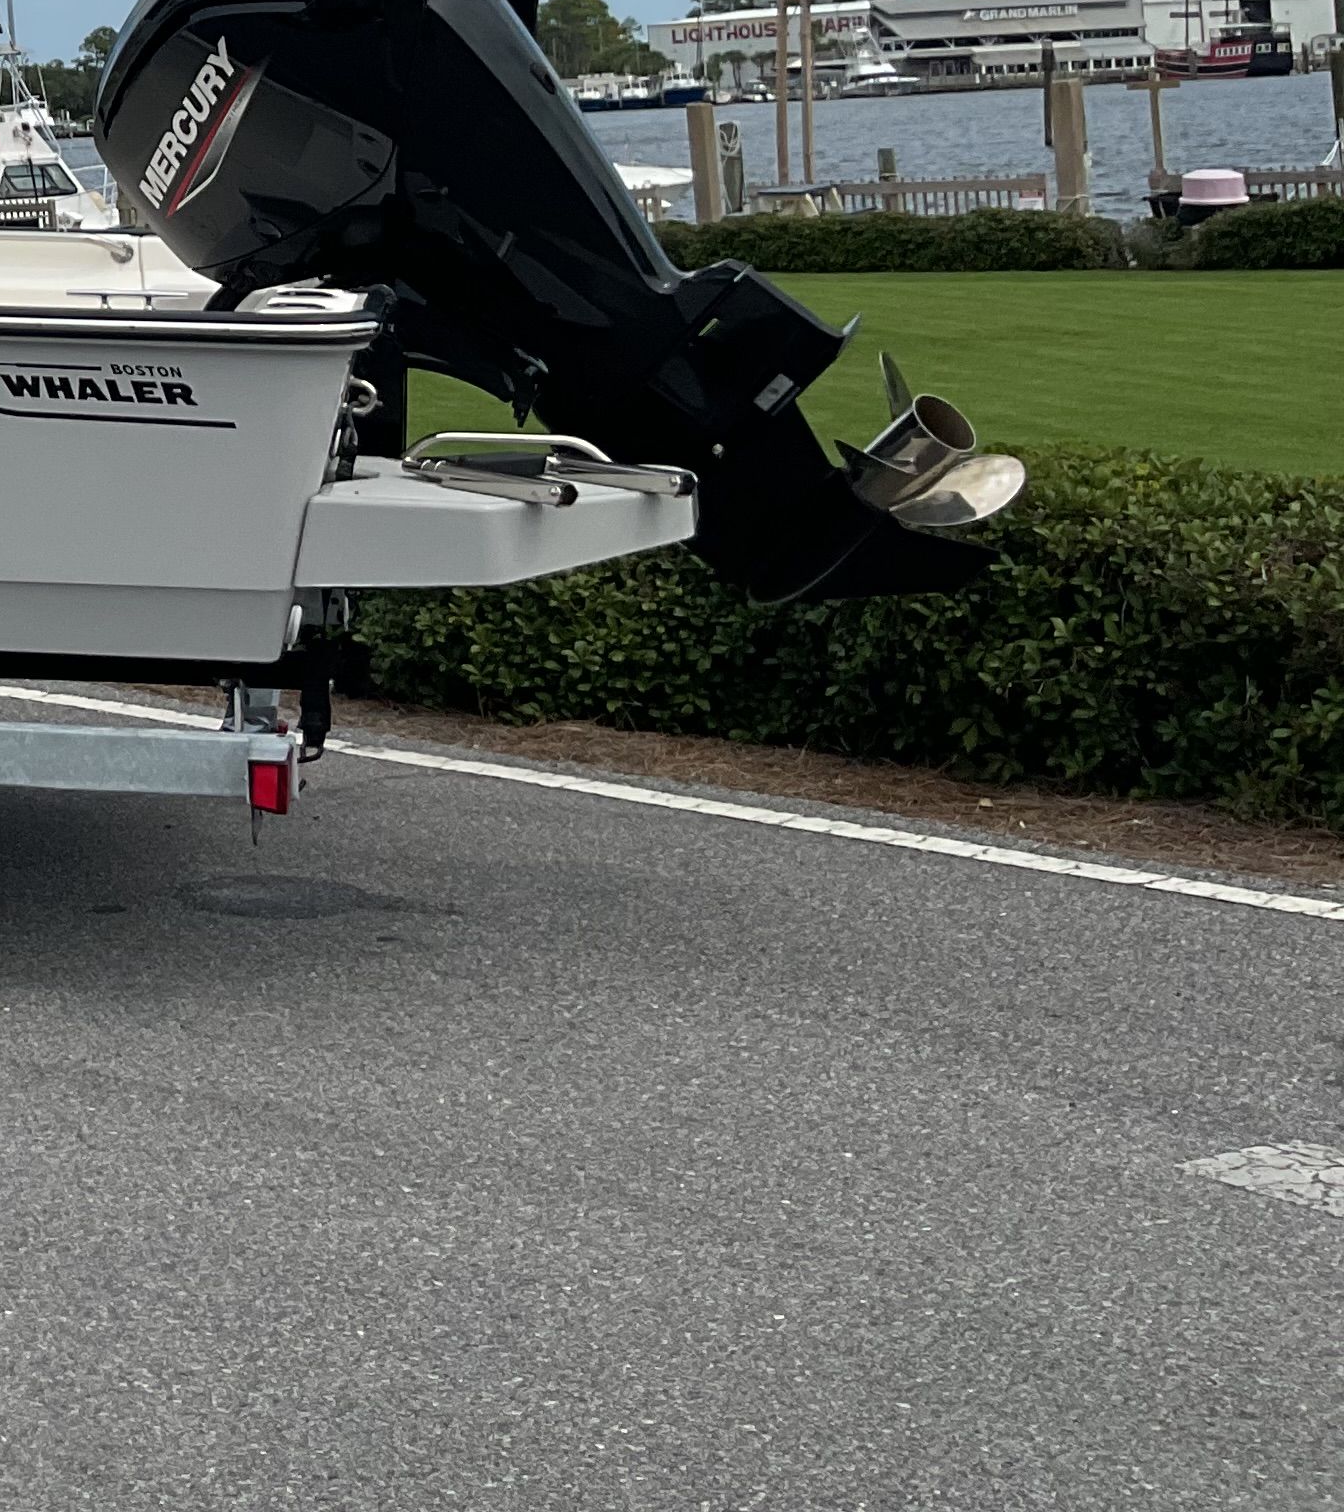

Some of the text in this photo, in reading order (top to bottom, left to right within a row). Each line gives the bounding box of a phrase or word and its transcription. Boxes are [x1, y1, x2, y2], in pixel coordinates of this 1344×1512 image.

[671, 21, 789, 45] LIGHTHOUS
[139, 36, 235, 209] MERCURY
[110, 364, 182, 378] BOSTON
[0, 373, 199, 406] WHALER
